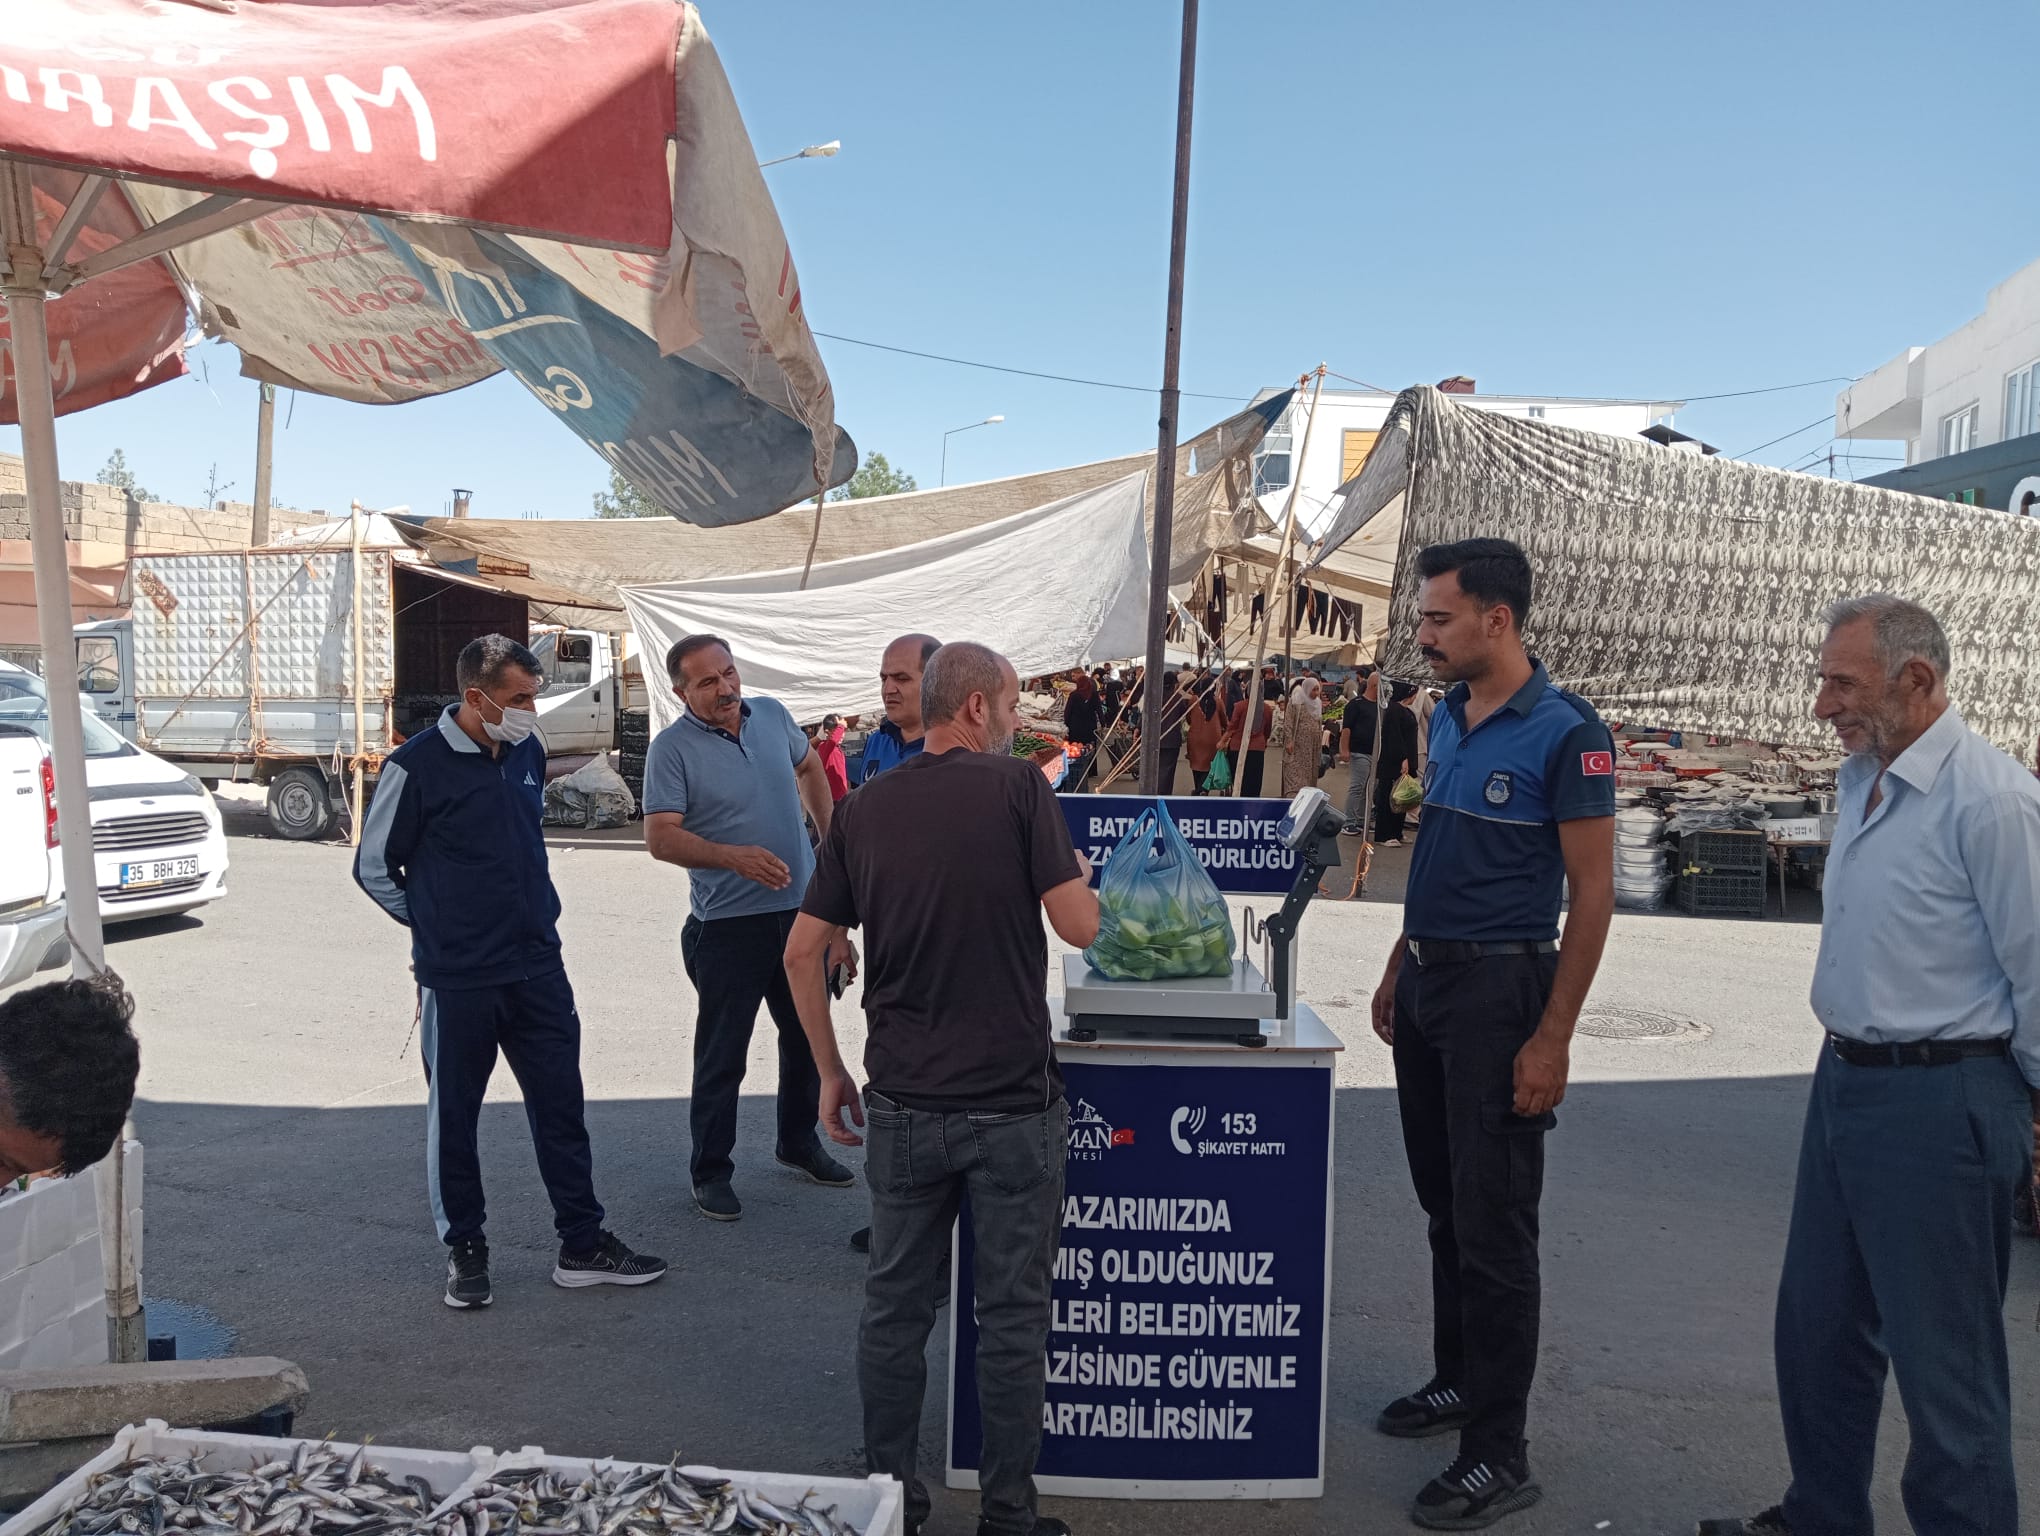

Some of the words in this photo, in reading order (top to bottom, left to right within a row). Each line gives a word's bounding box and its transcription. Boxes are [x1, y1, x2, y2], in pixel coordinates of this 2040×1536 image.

[1178, 815, 1281, 840] BELEDİYE
[129, 865, 144, 881] 35
[153, 862, 174, 879] BBH
[176, 859, 196, 875] 329
[1221, 1112, 1257, 1135] 153
[1197, 1138, 1248, 1158] ŞİKAYET
[1250, 1142, 1286, 1156] HATTI
[1061, 1195, 1232, 1232] AZARIMIZDA
[1101, 1242, 1274, 1285] OLDUĞUNUZ
[1119, 1295, 1301, 1337] BELEDİYEMİZ
[1168, 1348, 1297, 1389] GÜVENLE
